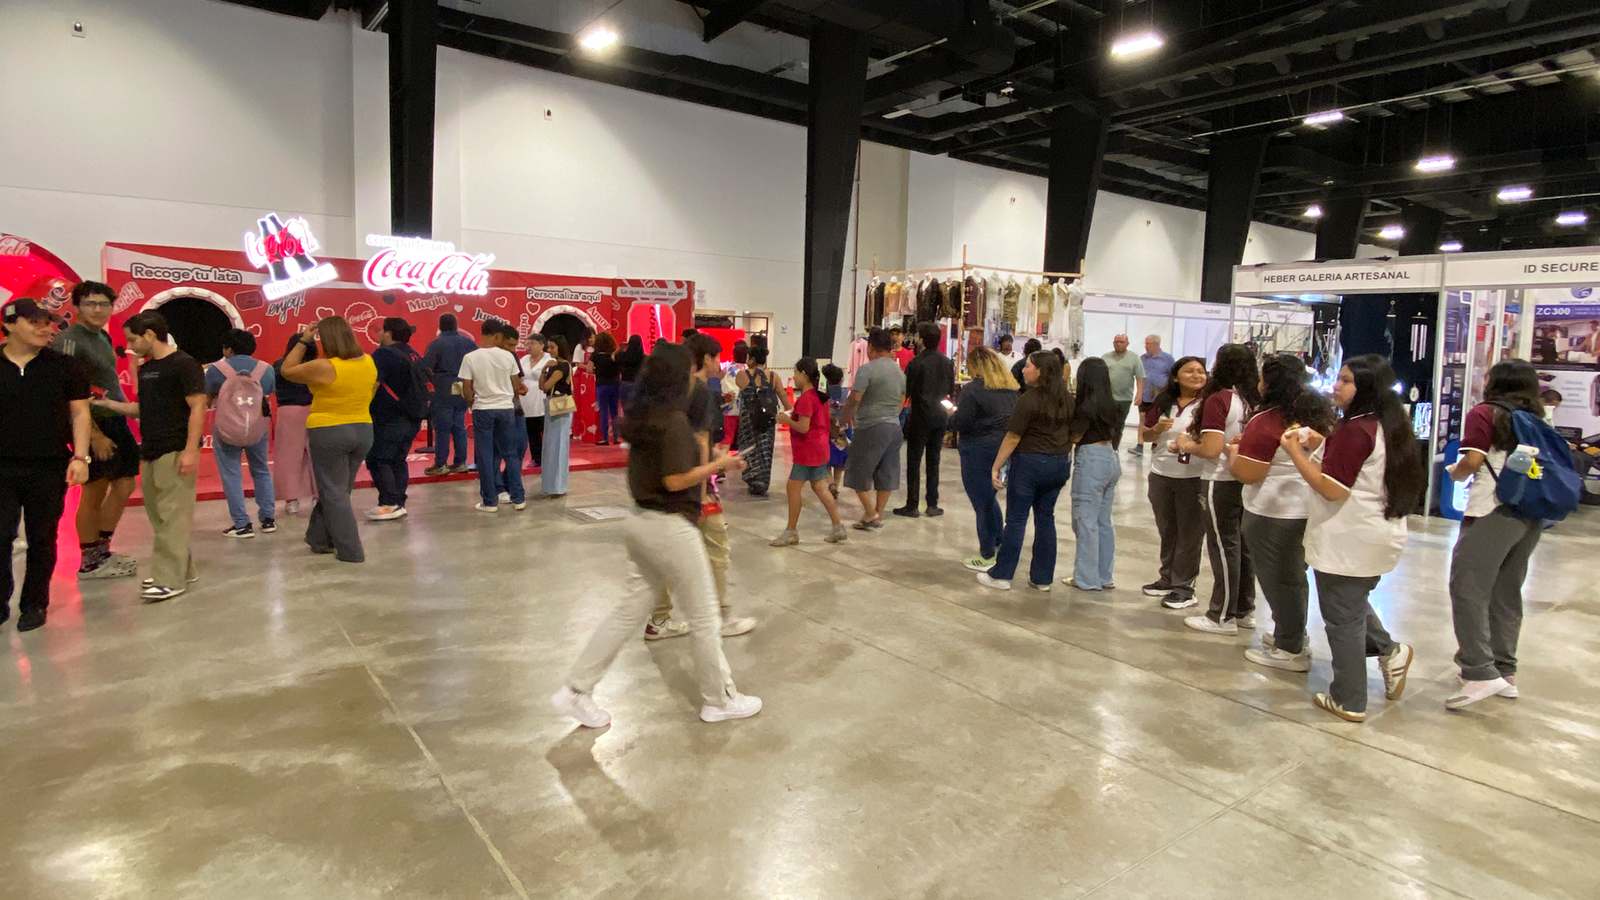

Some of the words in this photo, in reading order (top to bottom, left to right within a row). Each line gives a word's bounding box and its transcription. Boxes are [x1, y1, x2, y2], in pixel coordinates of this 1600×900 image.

[367, 235, 428, 249] comparte
[431, 241, 455, 252] una
[134, 265, 190, 282] Recoge
[195, 270, 209, 280] tu
[213, 269, 240, 282] lata
[367, 249, 487, 291] Coca-Cola
[1524, 265, 1537, 274] ID
[1541, 262, 1599, 273] SECURE
[1264, 275, 1296, 283] HEBER
[1298, 273, 1342, 282] GALERIA
[1344, 271, 1410, 281] ARTESANAL
[407, 294, 448, 312] Magia
[528, 289, 579, 300] Personaliza
[267, 290, 305, 323] enjoy!
[1536, 307, 1571, 315] ZC300
[587, 306, 611, 330] Amor
